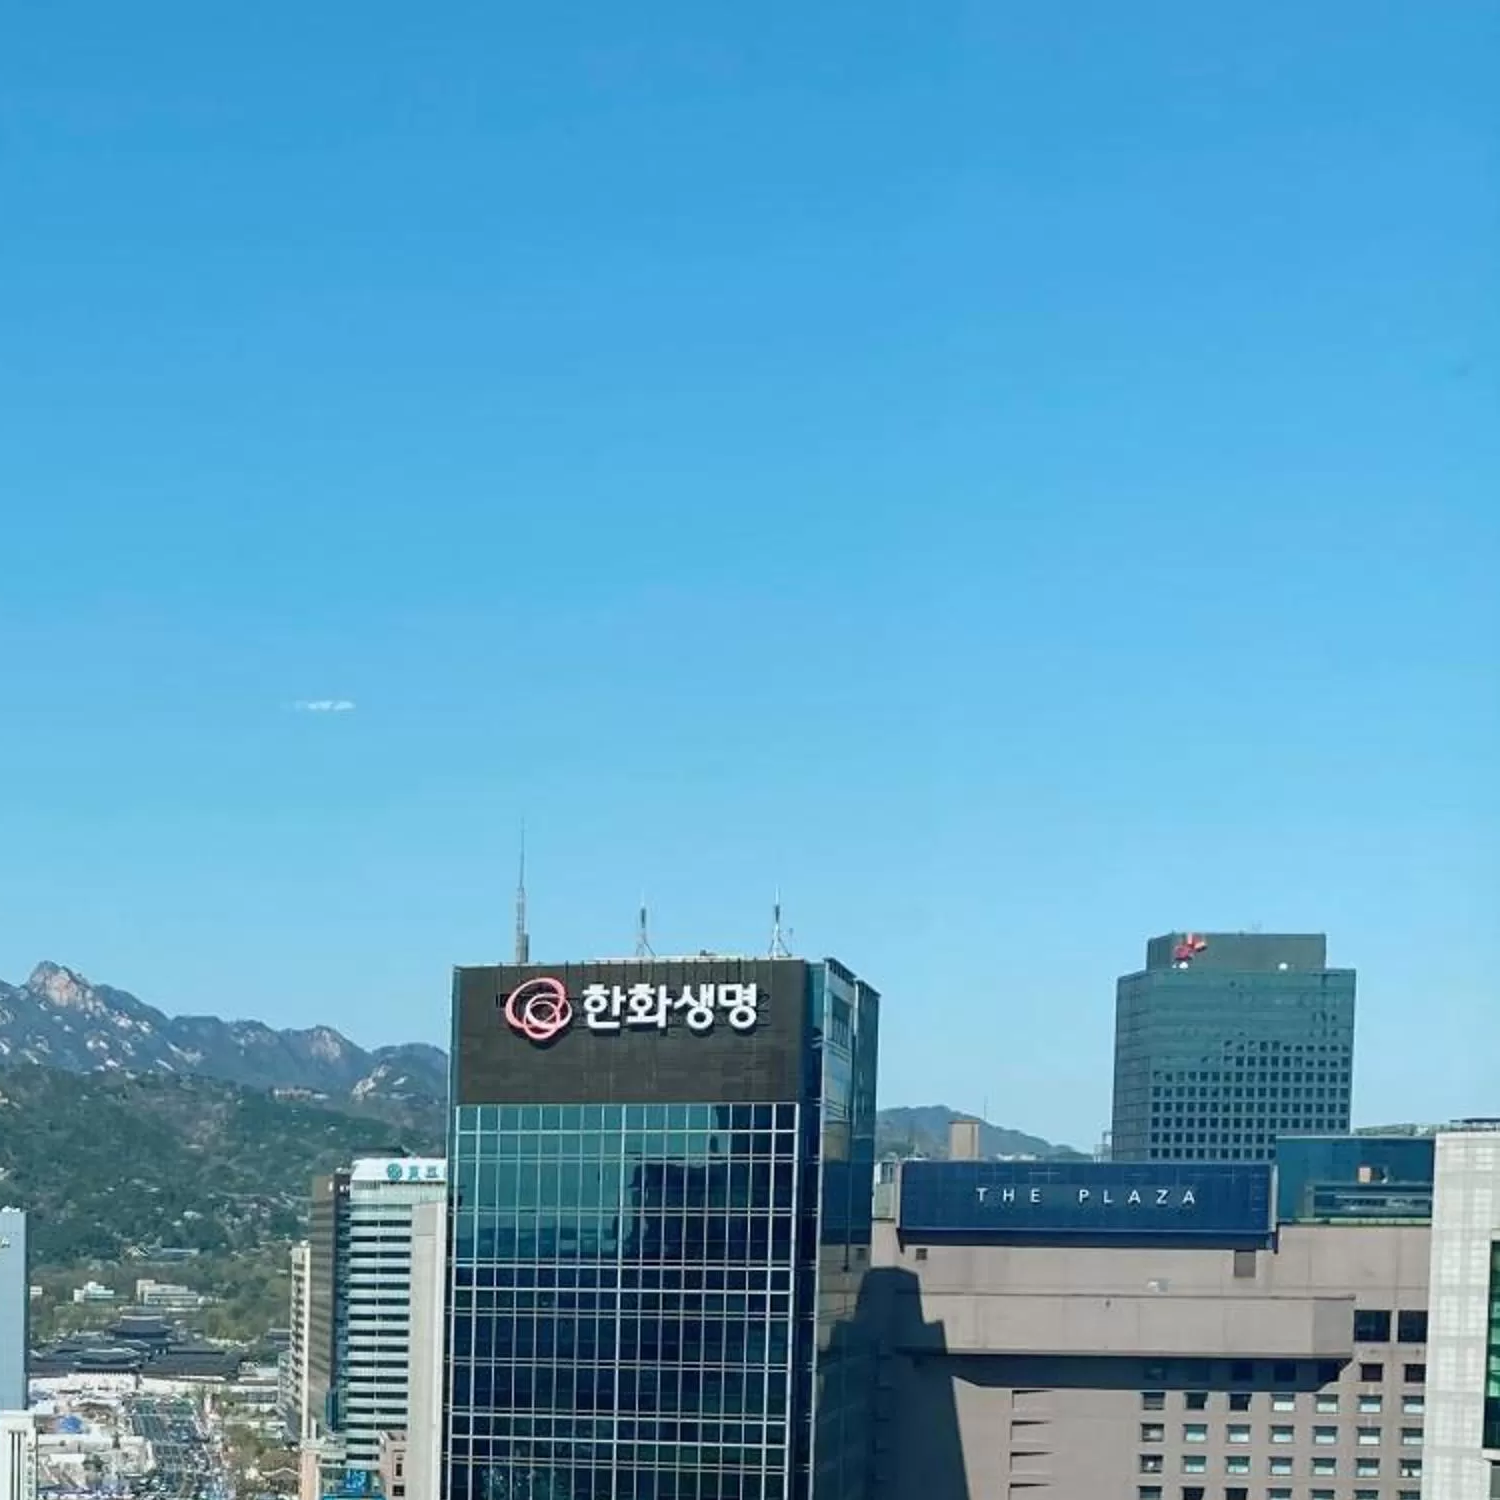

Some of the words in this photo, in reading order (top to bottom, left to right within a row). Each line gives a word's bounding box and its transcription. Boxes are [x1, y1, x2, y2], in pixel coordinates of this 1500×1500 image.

[582, 983, 758, 1030] 한화생명
[975, 1187, 1041, 1204] THE
[1078, 1188, 1196, 1205] PLAZA
